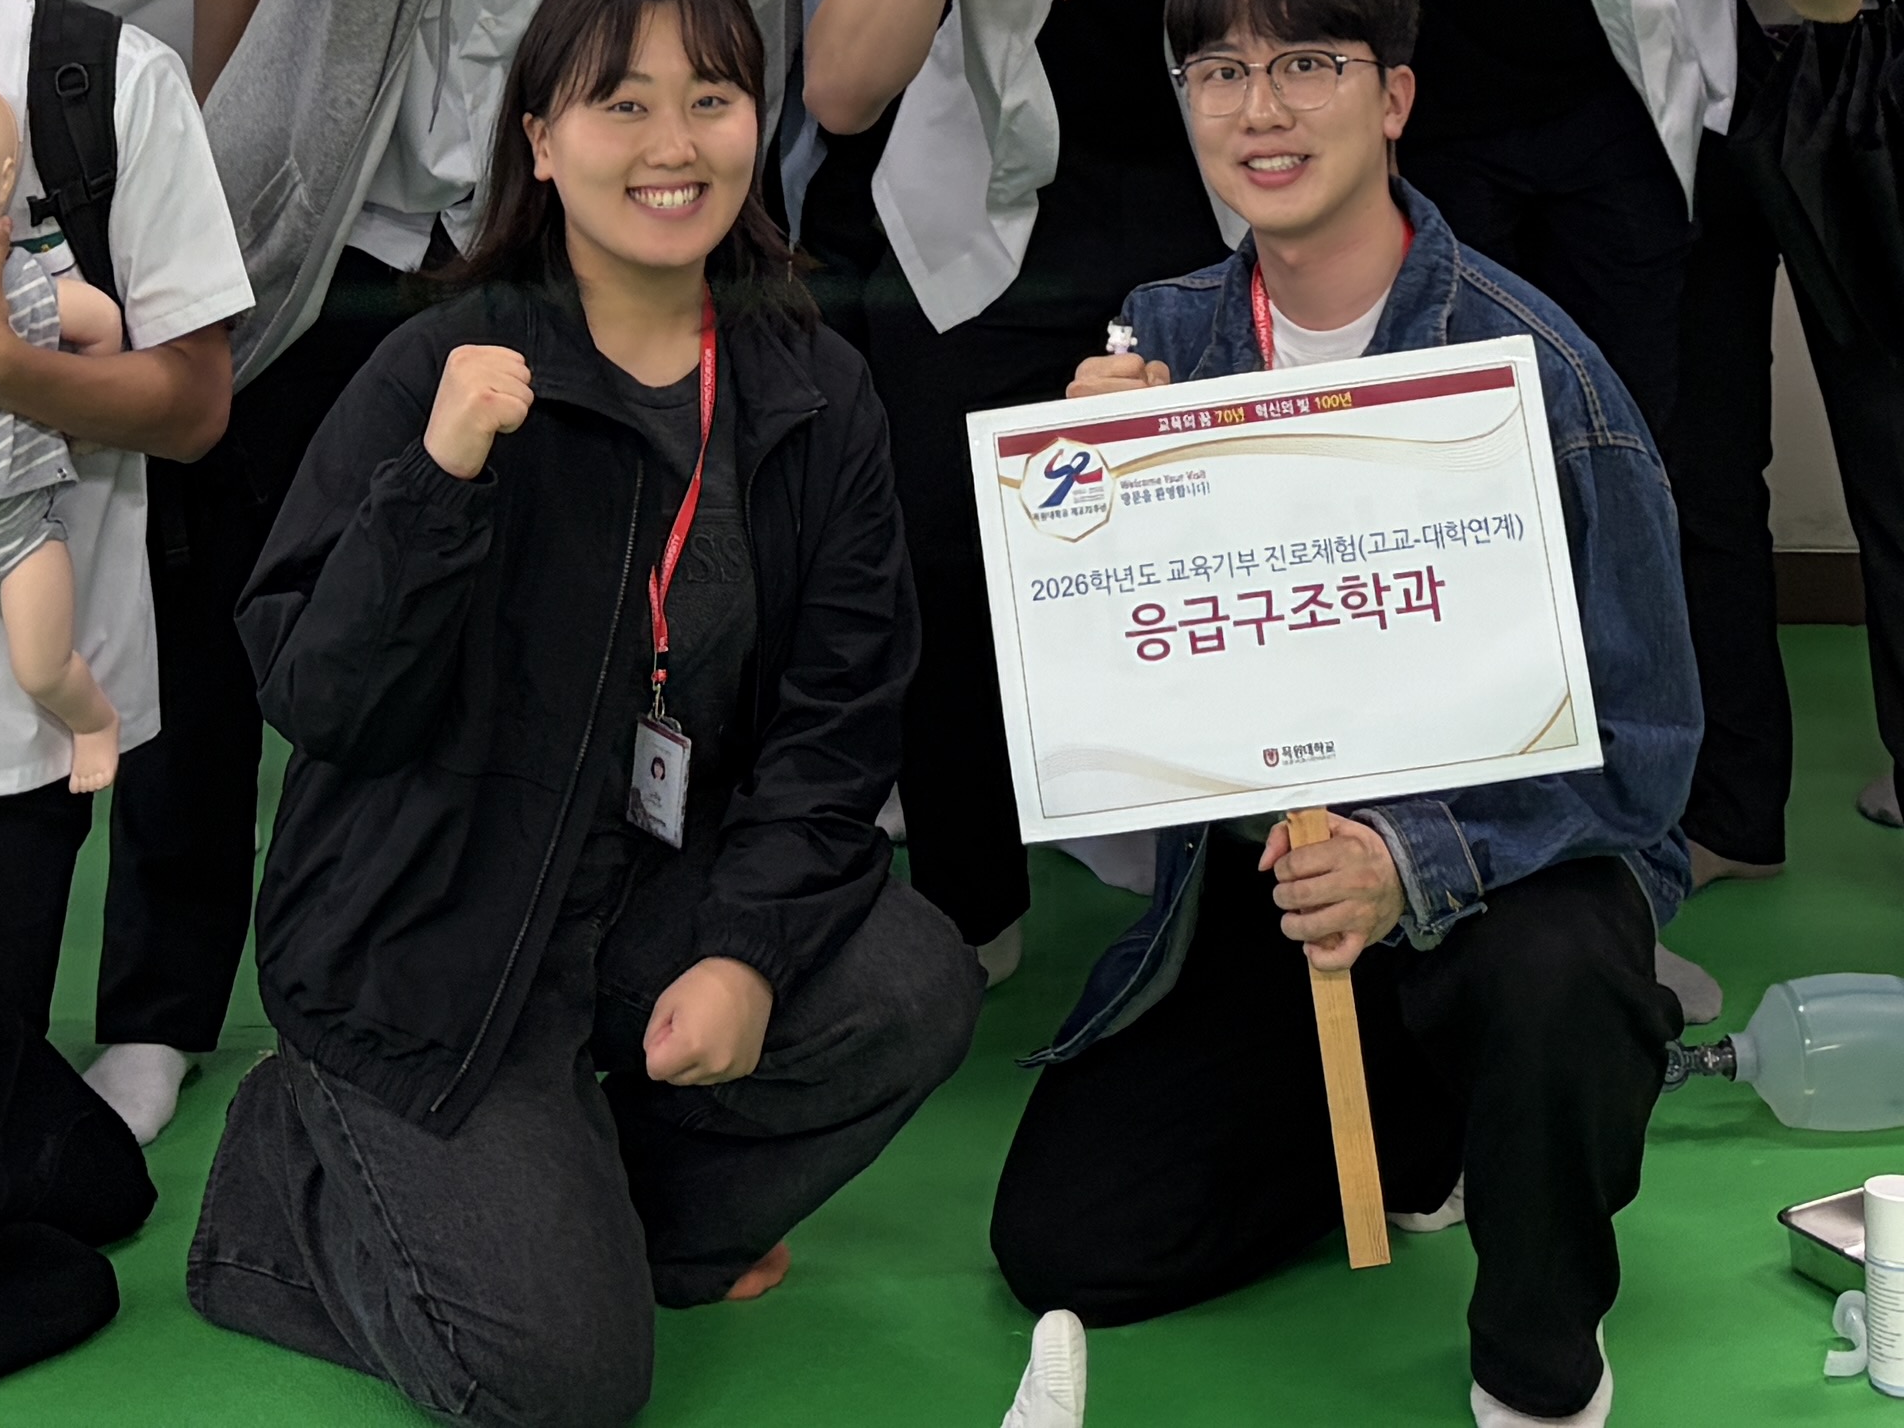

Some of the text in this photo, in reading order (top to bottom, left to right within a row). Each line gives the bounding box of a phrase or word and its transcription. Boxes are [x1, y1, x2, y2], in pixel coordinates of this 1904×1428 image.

[1214, 406, 1246, 424] 70년
[1255, 399, 1294, 419] 혁신의
[1297, 398, 1310, 414] 빛
[1314, 391, 1353, 410] 100년
[1120, 488, 1152, 506] 방문을
[1155, 481, 1210, 502] 환영합니다!
[1030, 513, 1526, 602] 2026학년도 교육기부 진로체험(고교-대학연계)
[1124, 564, 1446, 663] 응급구조학과
